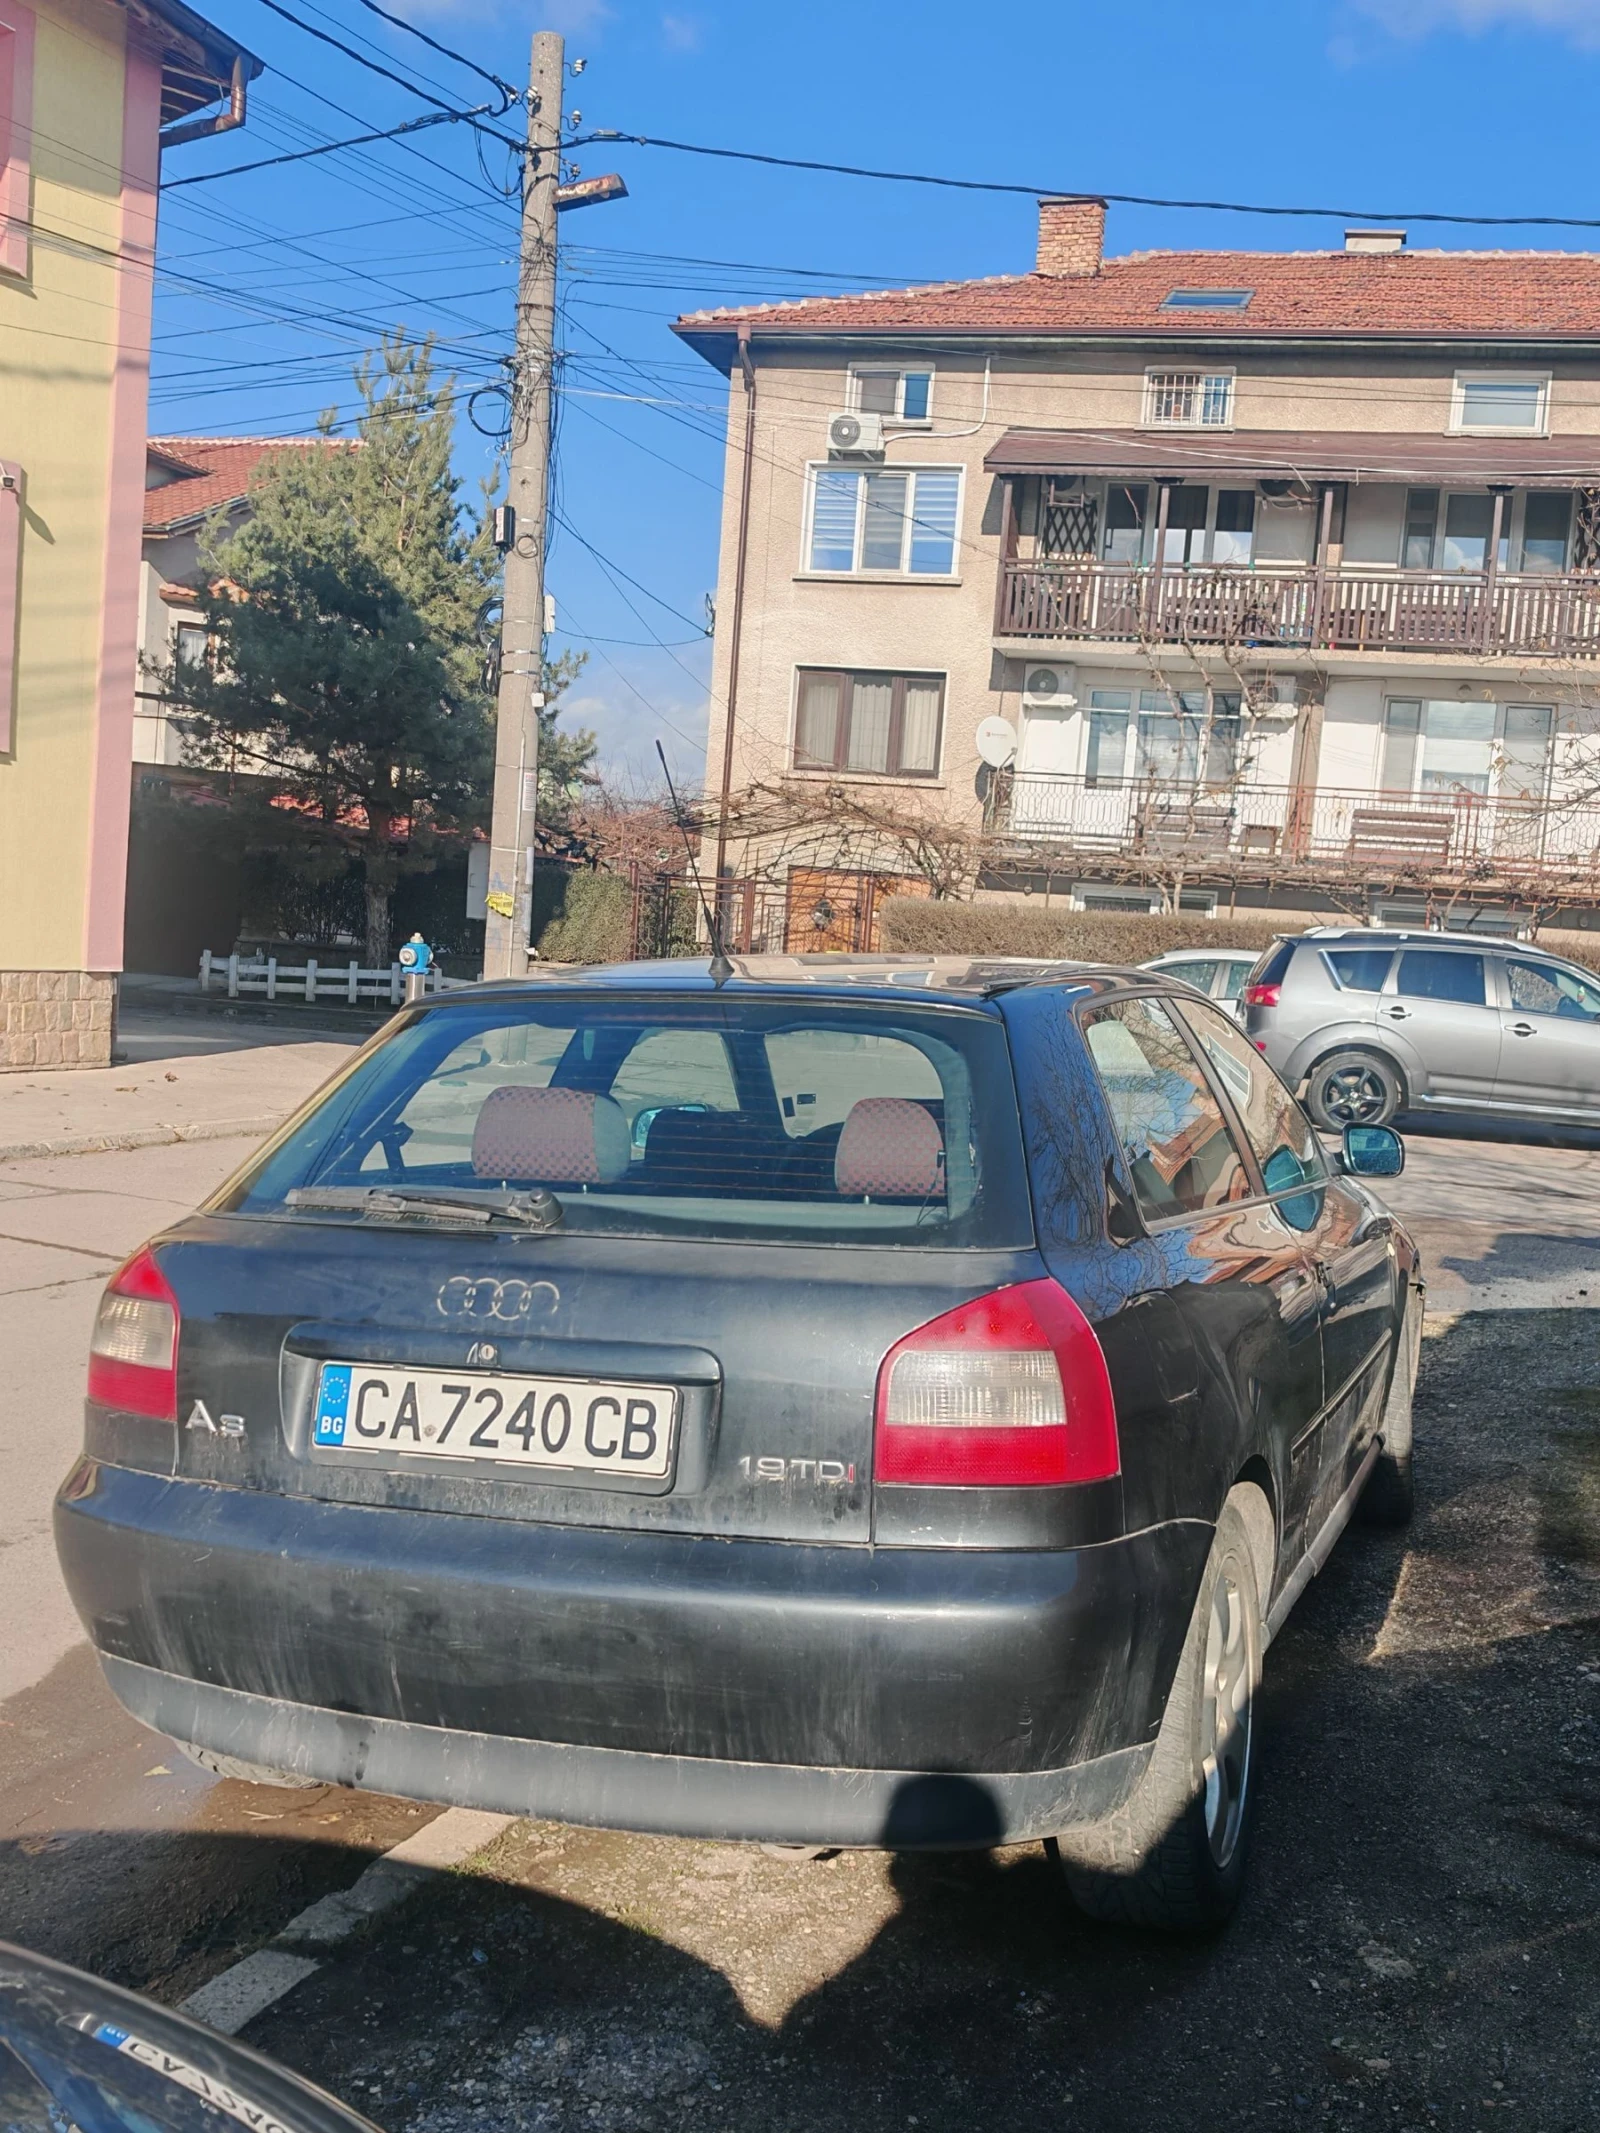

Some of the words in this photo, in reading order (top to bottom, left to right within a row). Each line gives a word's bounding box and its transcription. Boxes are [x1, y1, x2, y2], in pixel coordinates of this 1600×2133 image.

[184, 1399, 245, 1438] A3
[320, 1415, 344, 1436] BG
[354, 1379, 421, 1442] CA
[436, 1384, 572, 1453] 7240
[584, 1396, 657, 1461] CB
